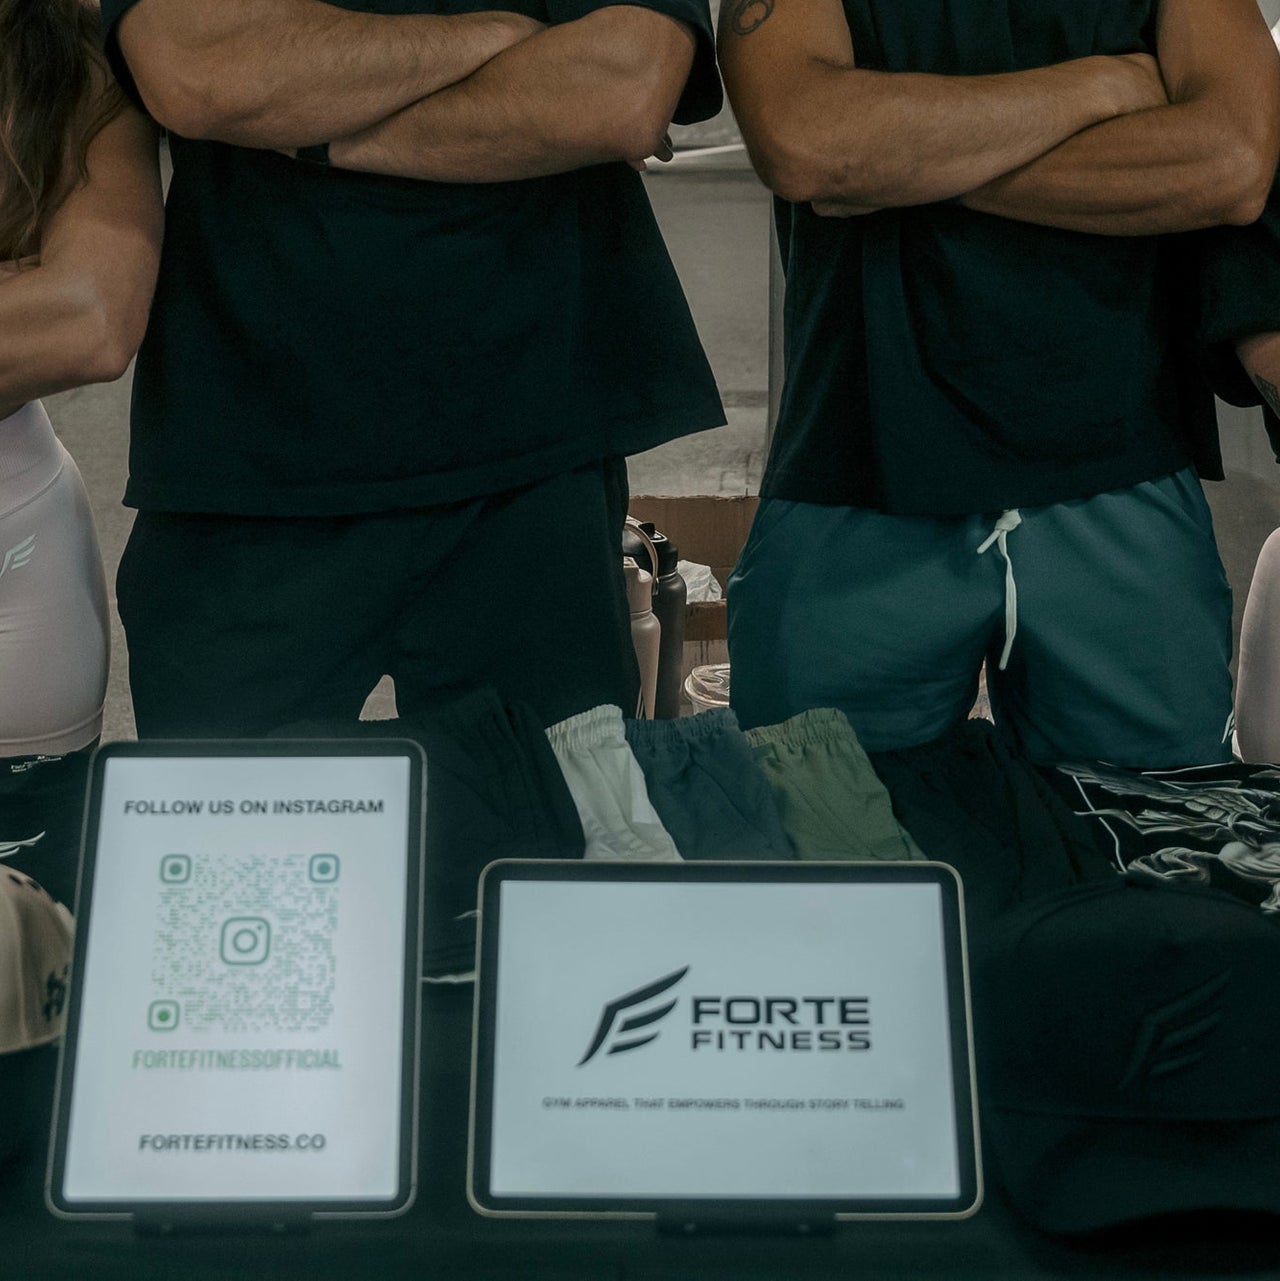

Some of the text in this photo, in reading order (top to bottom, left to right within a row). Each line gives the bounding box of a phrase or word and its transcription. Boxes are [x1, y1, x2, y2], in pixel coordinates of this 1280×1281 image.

[124, 799, 385, 815] FOLLOW US ON INSTAGRAM
[692, 997, 870, 1024] FORTE
[692, 1031, 871, 1050] FITNESS
[132, 1049, 342, 1070] FORTEFITNESSOFFICIAL
[542, 1097, 905, 1110] GYM APPAREL THAT EMPOWERS THROUGH STORY TELLING
[139, 1133, 327, 1151] FORTEFITNESS.CO
